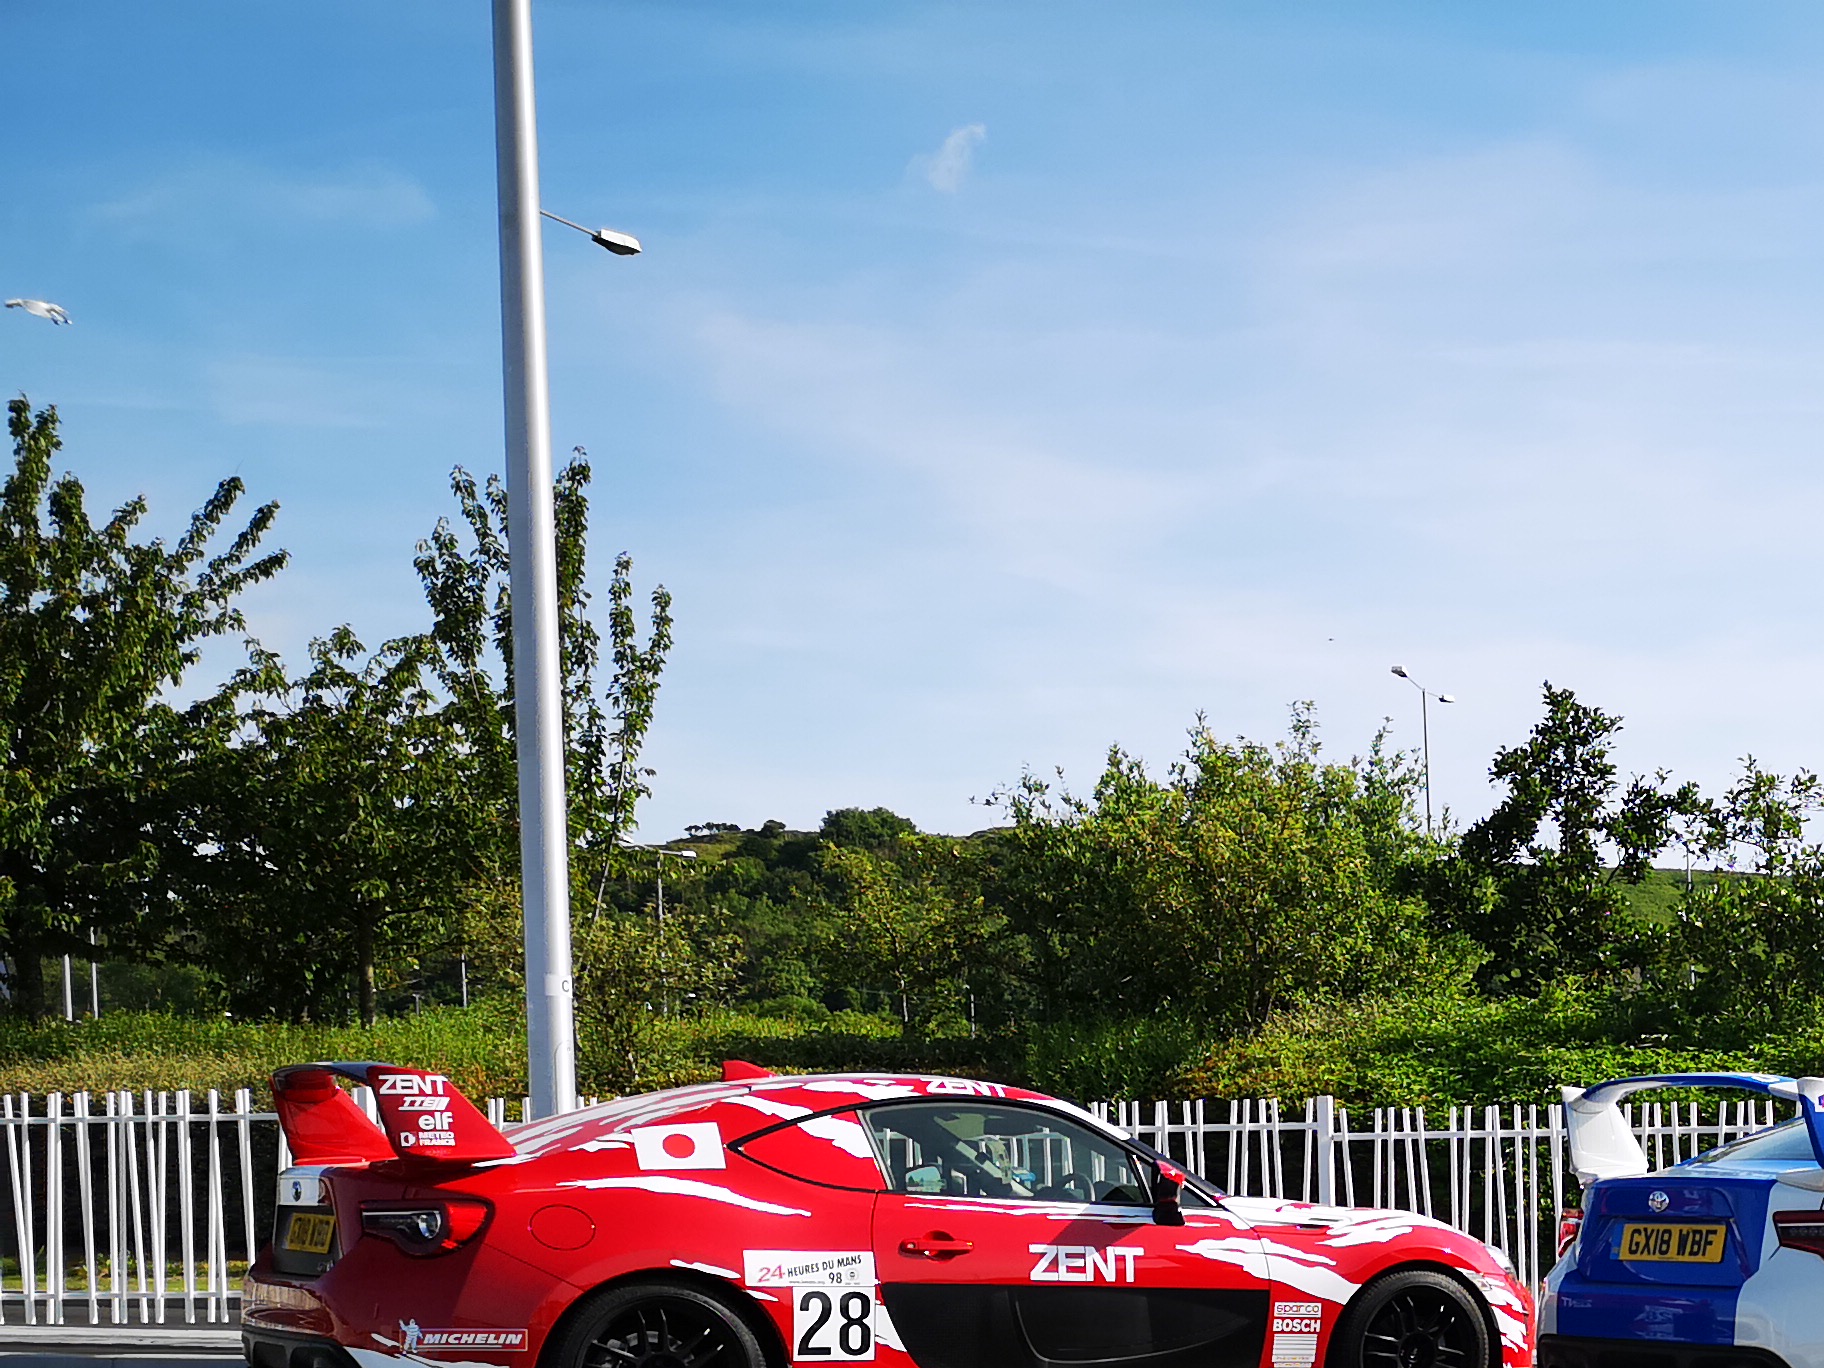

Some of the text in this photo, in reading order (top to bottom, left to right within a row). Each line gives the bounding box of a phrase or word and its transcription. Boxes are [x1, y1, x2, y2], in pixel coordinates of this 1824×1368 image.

[378, 1075, 448, 1095] ZENT
[920, 1078, 1008, 1098] ZENT
[418, 1112, 454, 1130] elf
[1628, 1227, 1717, 1256] GX18 WBF
[757, 1264, 785, 1283] 24
[787, 1263, 819, 1277] HEURES
[822, 1260, 834, 1271] DU
[837, 1255, 862, 1268] MANS
[1029, 1244, 1144, 1282] ZENT
[829, 1272, 842, 1284] 98
[1276, 1304, 1320, 1315] sparco
[798, 1291, 871, 1356] 28
[1273, 1319, 1321, 1332] BOSCH
[423, 1333, 523, 1344] MICHELIN
